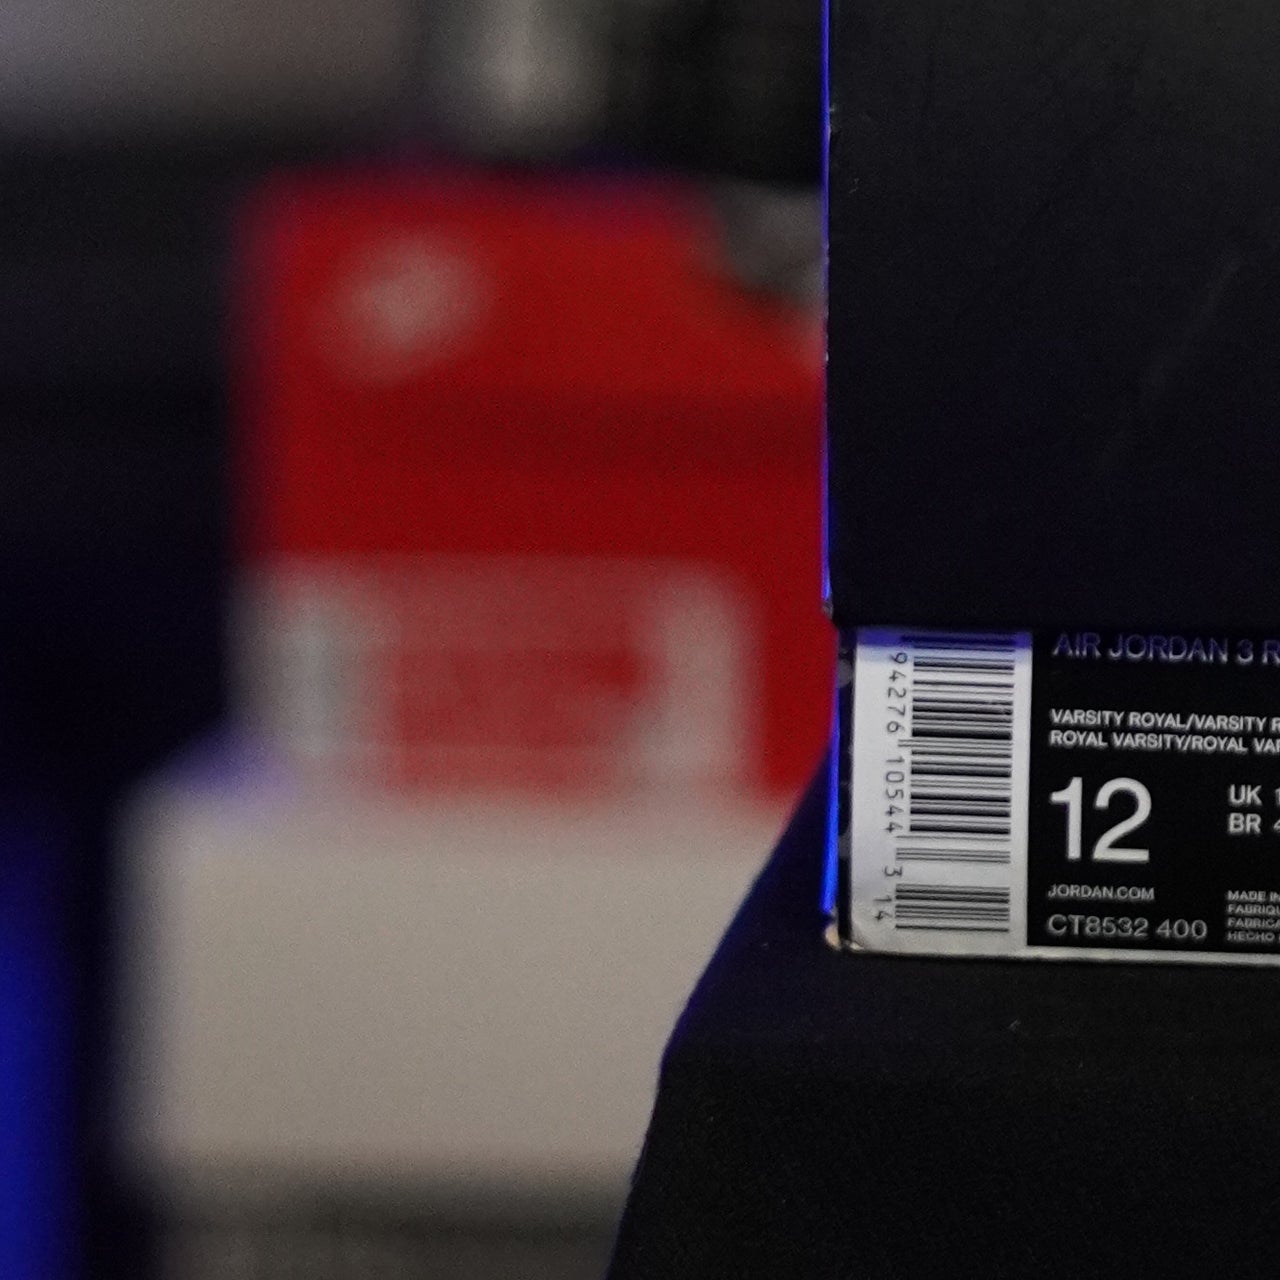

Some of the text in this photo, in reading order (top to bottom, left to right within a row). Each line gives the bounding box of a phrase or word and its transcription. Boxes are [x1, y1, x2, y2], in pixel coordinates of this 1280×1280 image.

[1052, 632, 1101, 658] AIR
[1108, 633, 1228, 664] JORDAN
[1236, 639, 1254, 665] 3
[887, 651, 908, 734] 94276
[1050, 708, 1124, 726] VARSITY
[1128, 712, 1266, 731] ROYAL/VARSITY
[1050, 730, 1107, 748] ROYAL
[1112, 732, 1247, 752] VARSITY/ROYAL
[885, 756, 905, 834] 10544
[1228, 784, 1262, 806] UK
[1049, 776, 1152, 863] 12
[1228, 813, 1261, 834] BR
[1048, 883, 1155, 901] JORDAN.COM
[1227, 890, 1266, 902] MADE
[1047, 913, 1208, 940] CT8532 400
